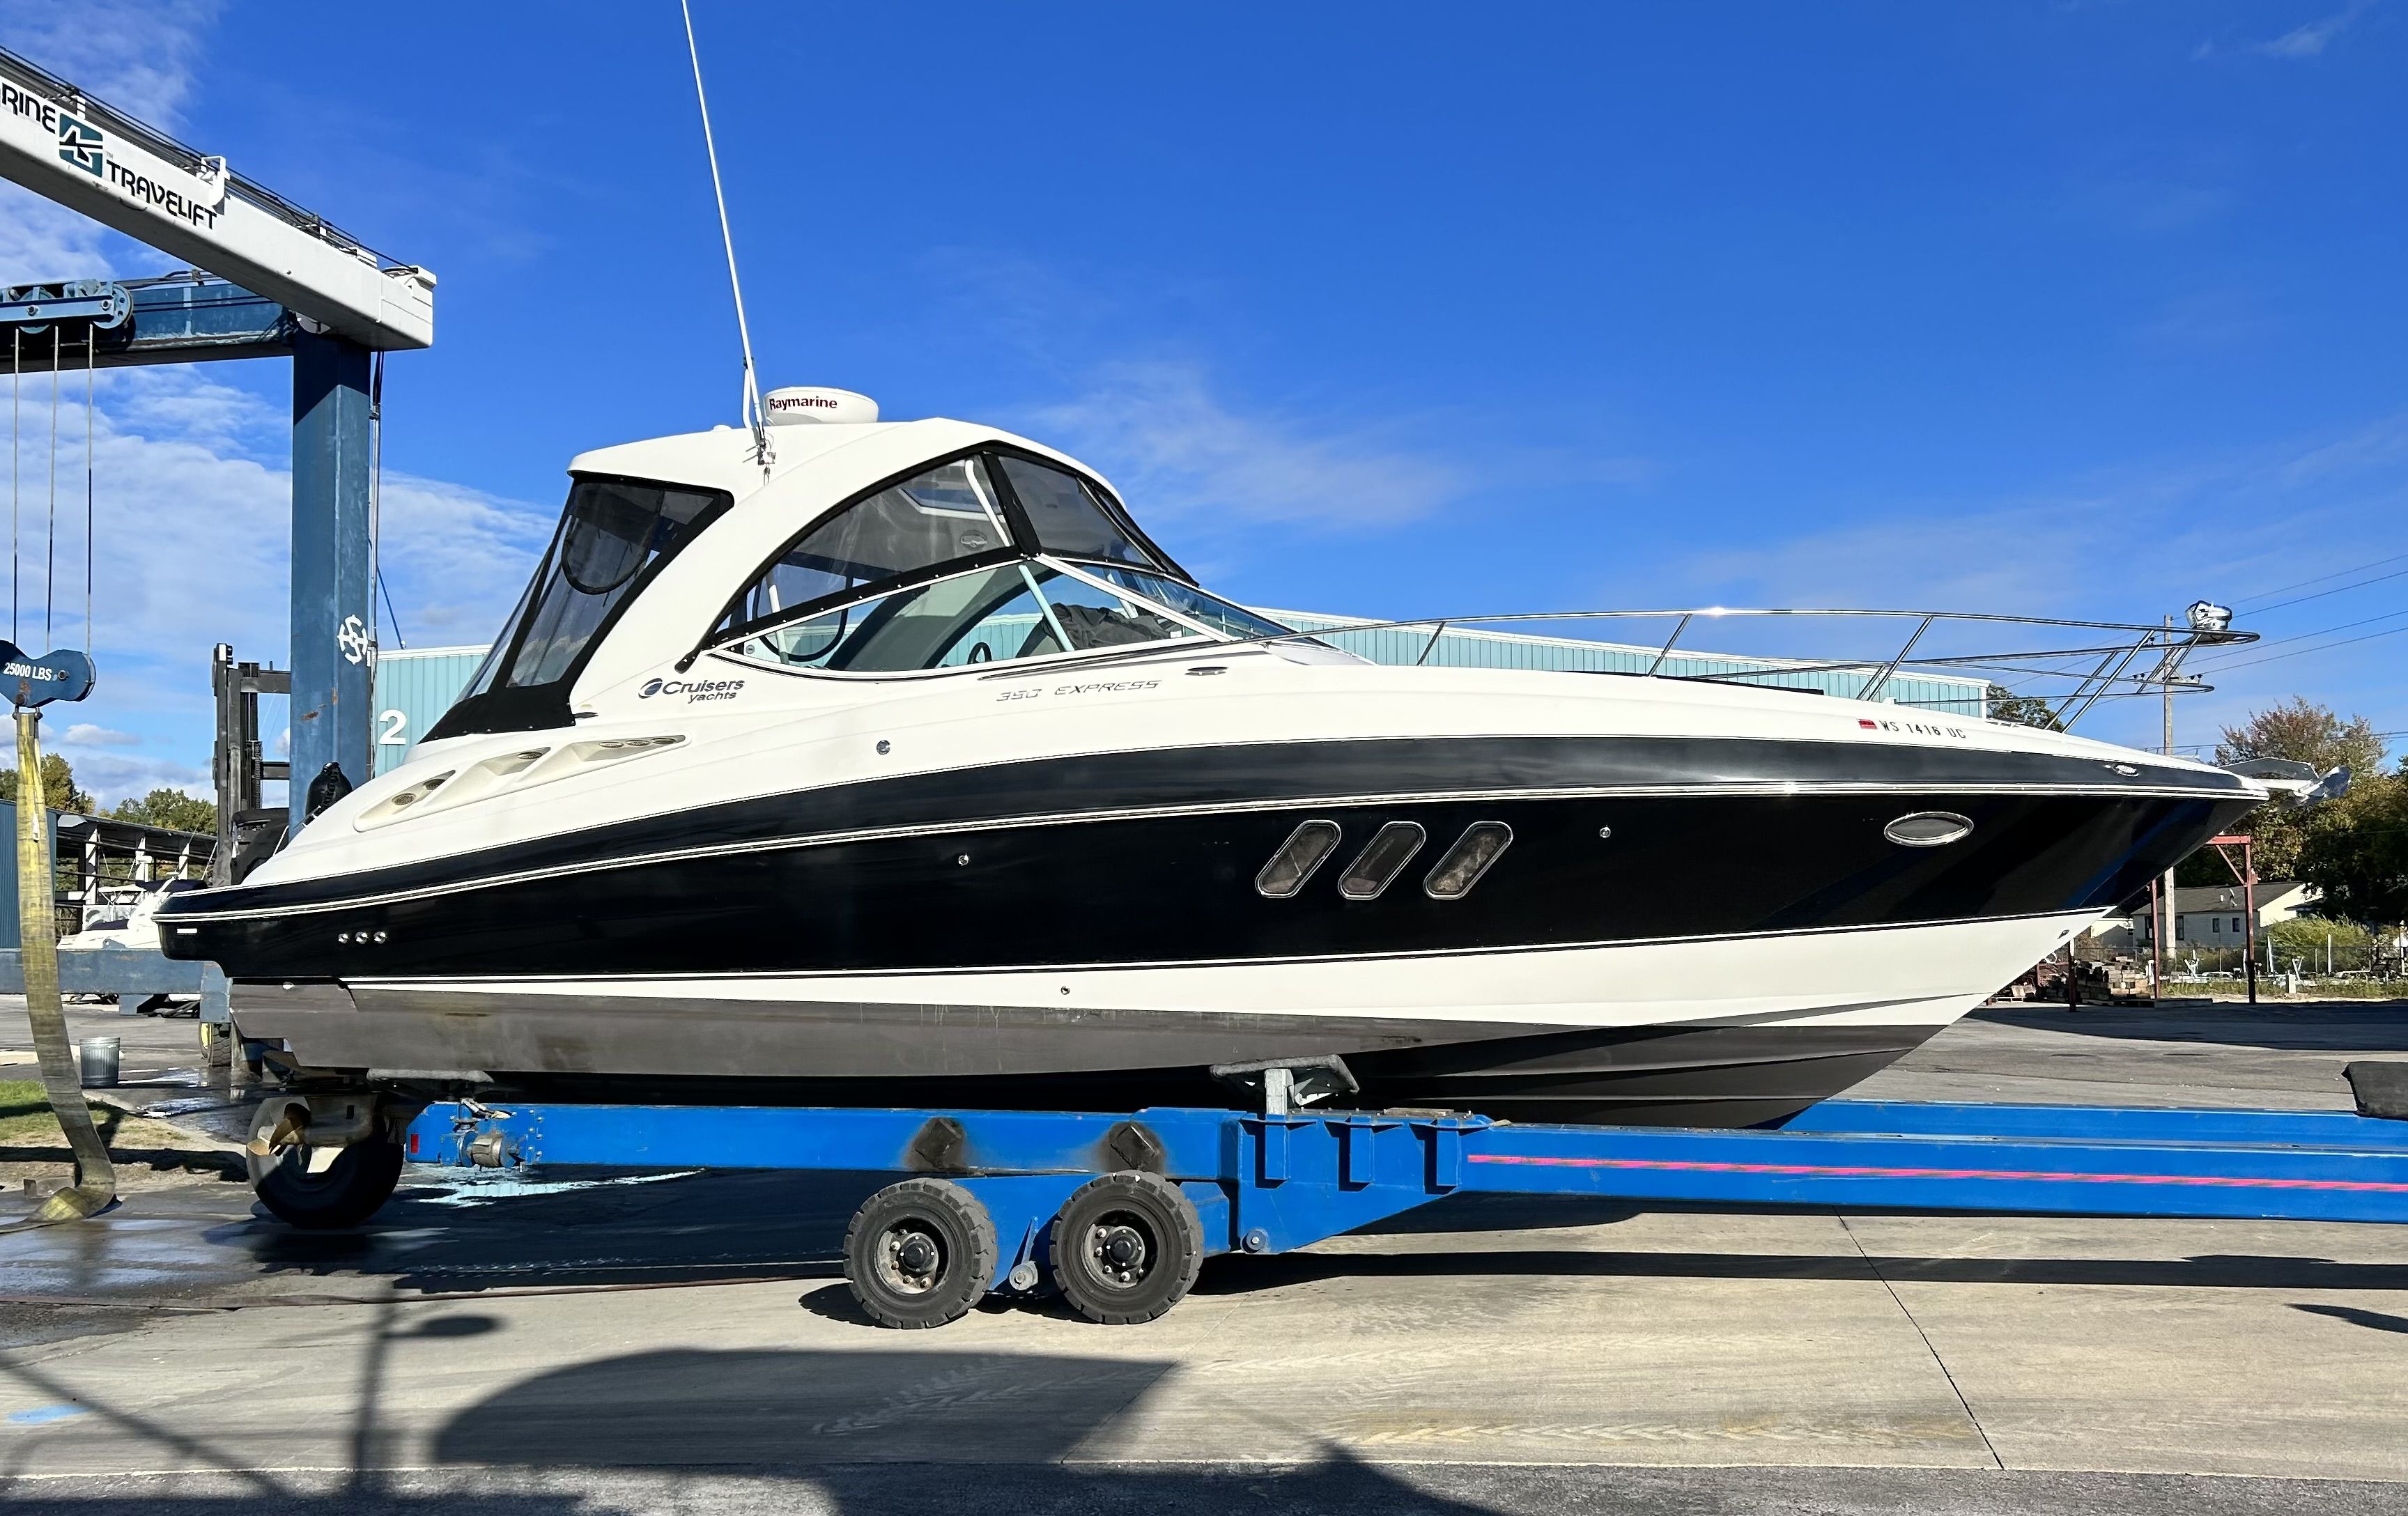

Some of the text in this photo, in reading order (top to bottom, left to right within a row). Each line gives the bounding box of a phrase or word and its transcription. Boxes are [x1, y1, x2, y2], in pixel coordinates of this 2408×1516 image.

[0, 82, 218, 230] RINE TRAVELIFT
[769, 396, 838, 411] Raymarine
[3, 662, 53, 681] 25000 LBS
[662, 679, 745, 695] Cruisers
[1054, 679, 1162, 695] EXPRESS
[687, 691, 737, 704] yachts
[378, 709, 407, 745] 2
[1878, 720, 1900, 732] WS
